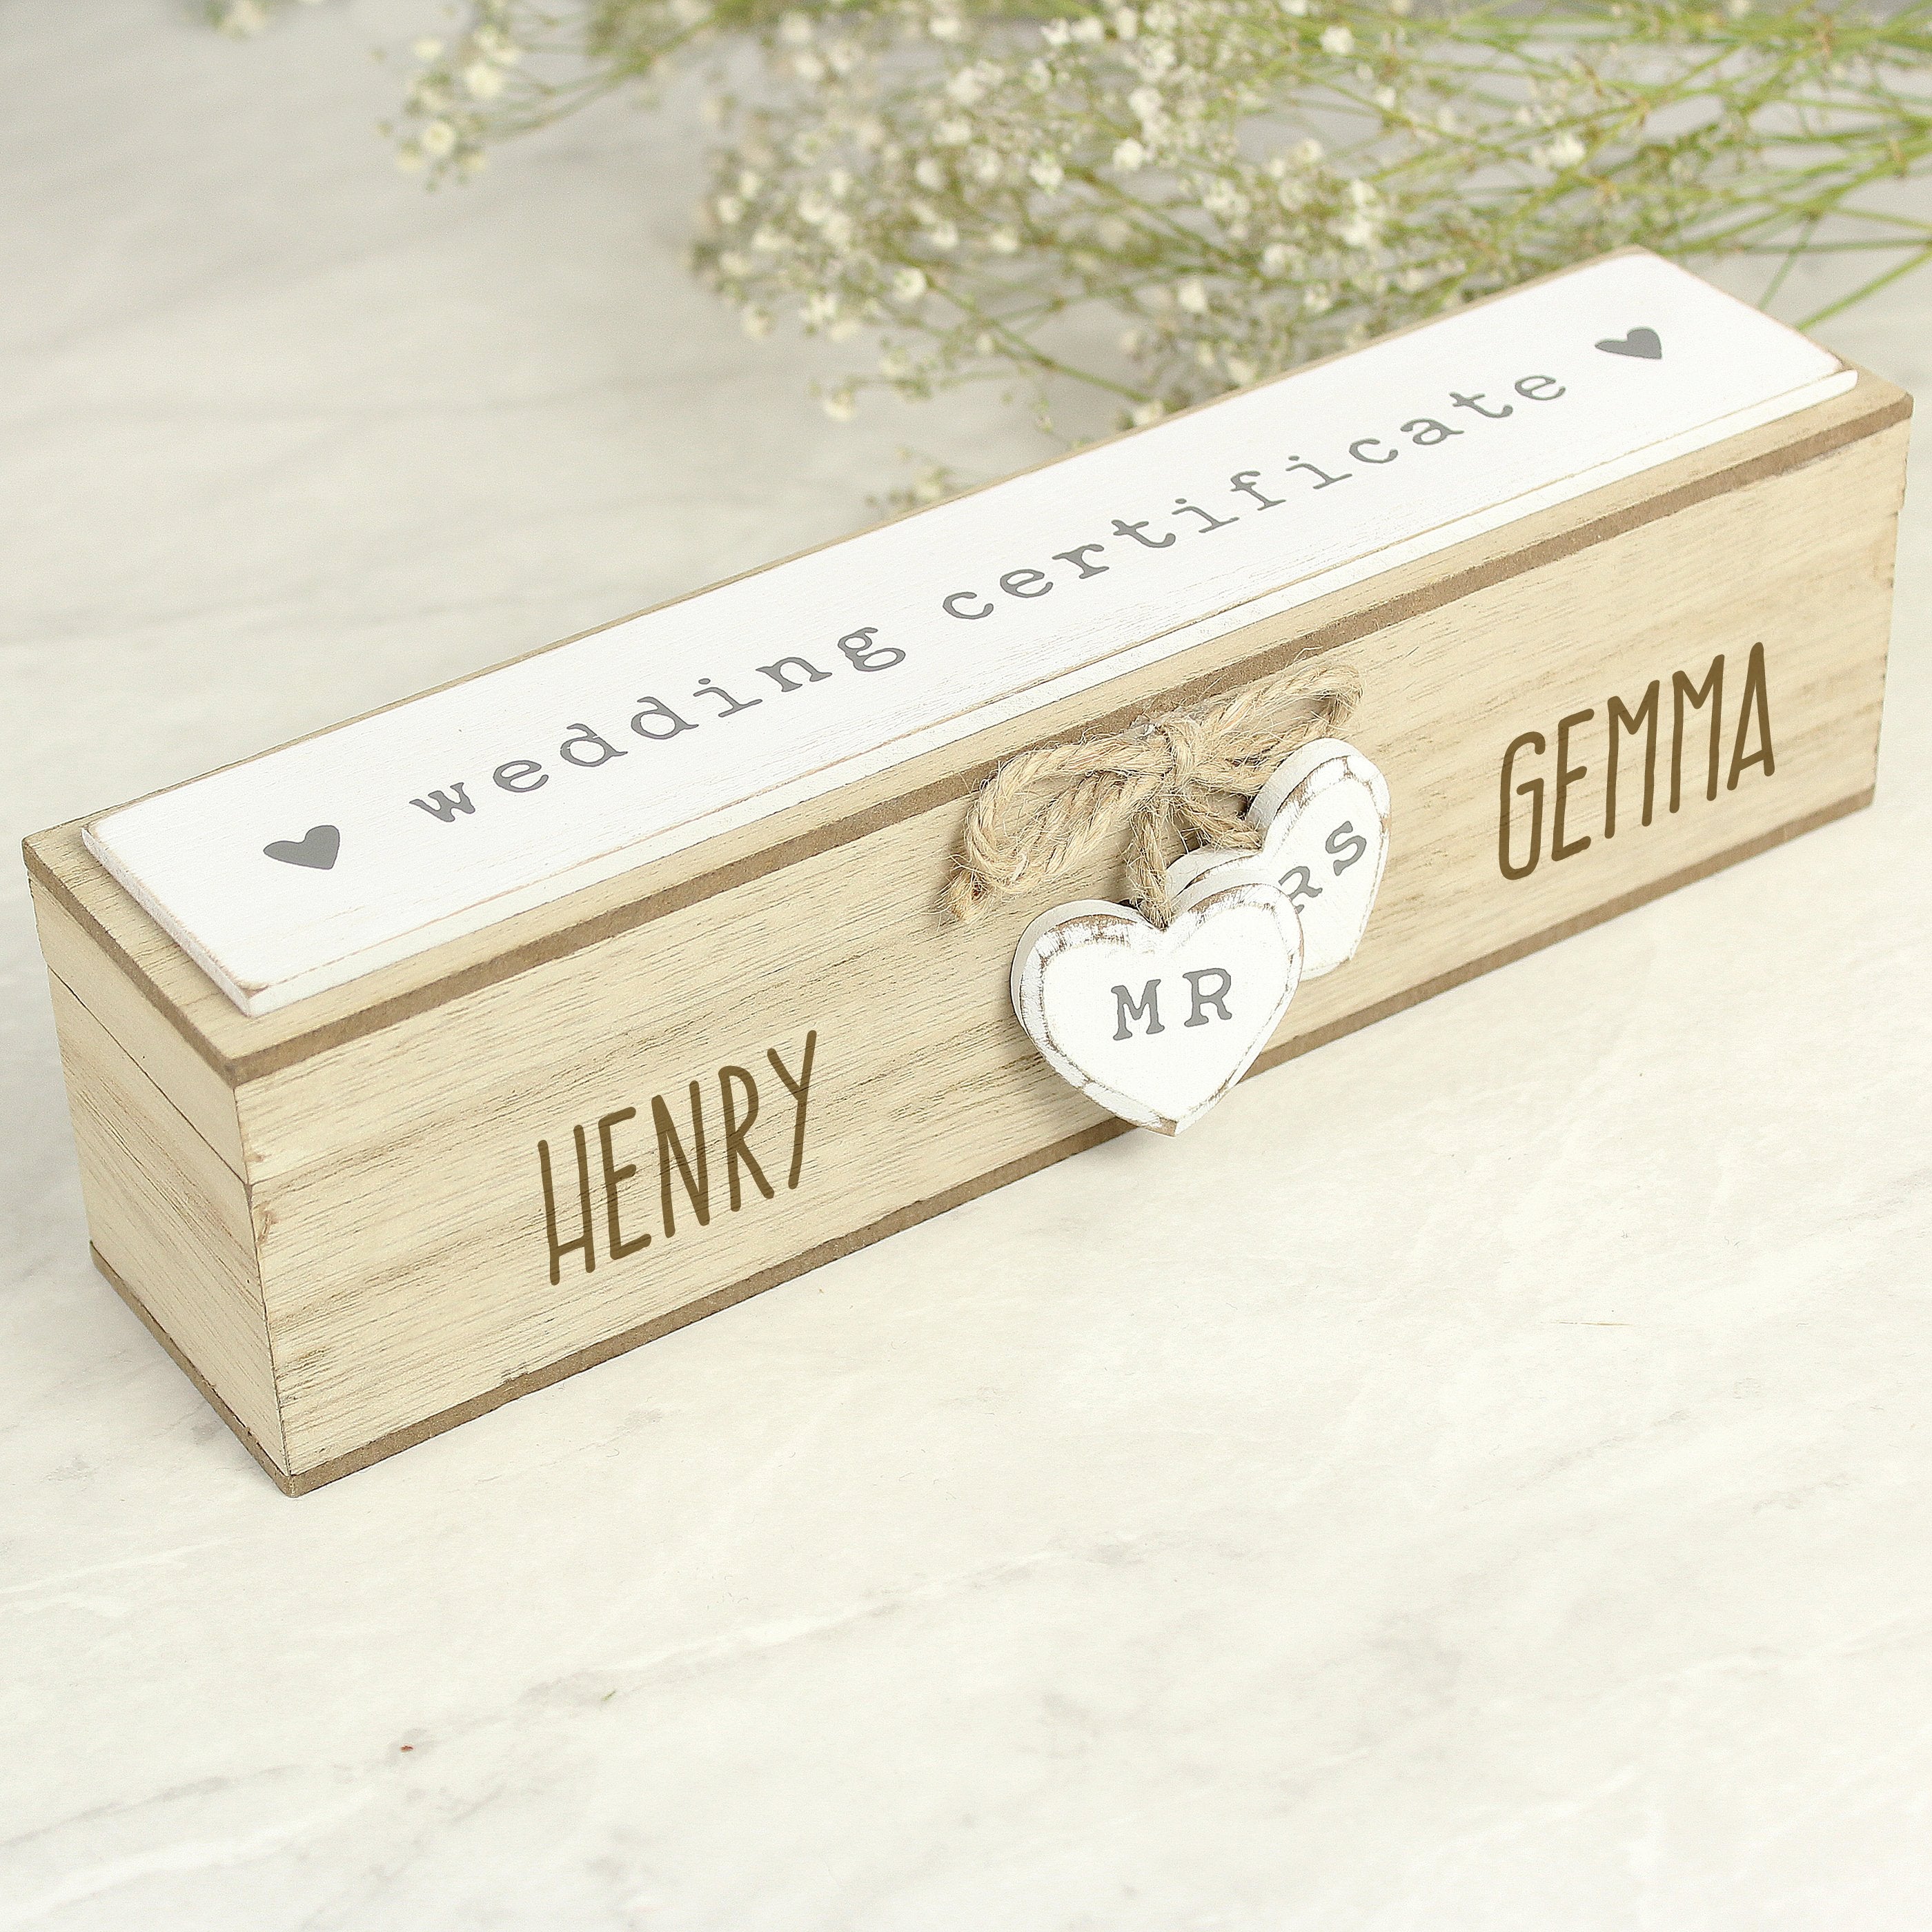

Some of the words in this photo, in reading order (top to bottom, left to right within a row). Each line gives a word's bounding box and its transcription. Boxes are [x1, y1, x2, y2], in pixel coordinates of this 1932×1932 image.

[408, 627, 906, 822] wedding
[942, 374, 1566, 620] certificate
[1279, 820, 1367, 914] RS
[1499, 642, 1775, 880] GEMMA
[1111, 967, 1232, 1041] MR
[538, 1030, 817, 1285] HENRY
